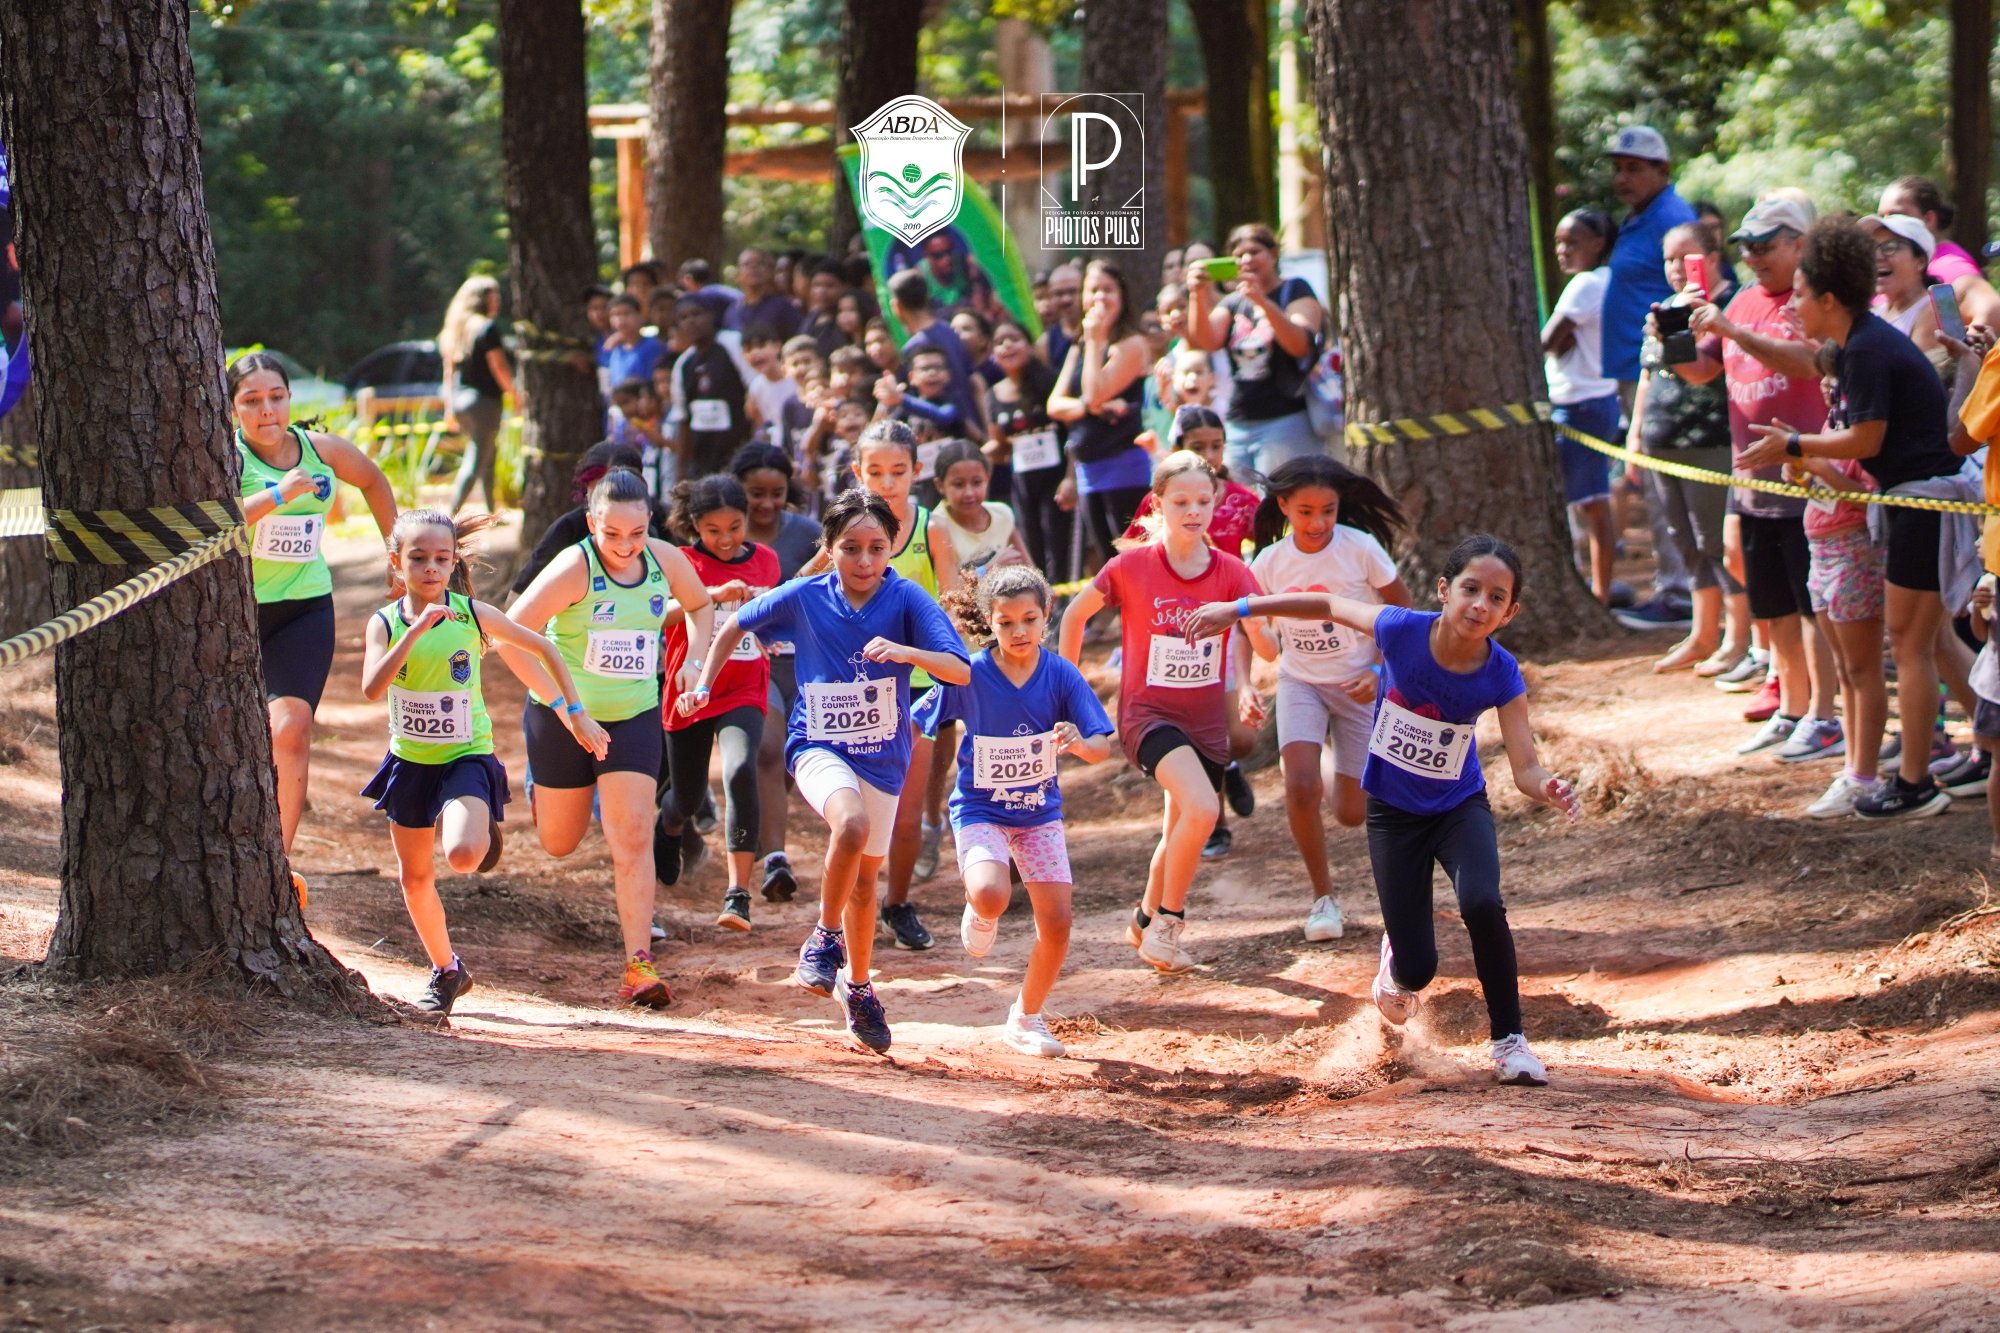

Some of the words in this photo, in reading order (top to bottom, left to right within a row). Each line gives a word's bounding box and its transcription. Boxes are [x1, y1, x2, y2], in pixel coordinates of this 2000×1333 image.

[268, 538, 312, 553] 2026
[1293, 636, 1340, 651] 2026
[600, 654, 645, 670] 2026
[1164, 662, 1210, 679] 2026
[401, 705, 436, 716] COUNTRY
[408, 701, 435, 709] CROSS
[821, 701, 861, 709] COUNTRY
[402, 715, 455, 734] 2026
[823, 708, 880, 730] 2026
[1392, 725, 1434, 745] COUNTRY
[1404, 723, 1433, 739] CROSS
[847, 745, 882, 755] BAURU
[989, 753, 1027, 761] COUNTRY
[1387, 735, 1448, 768] 2026
[990, 760, 1043, 779] 2026
[1004, 802, 1036, 812] BAURU
